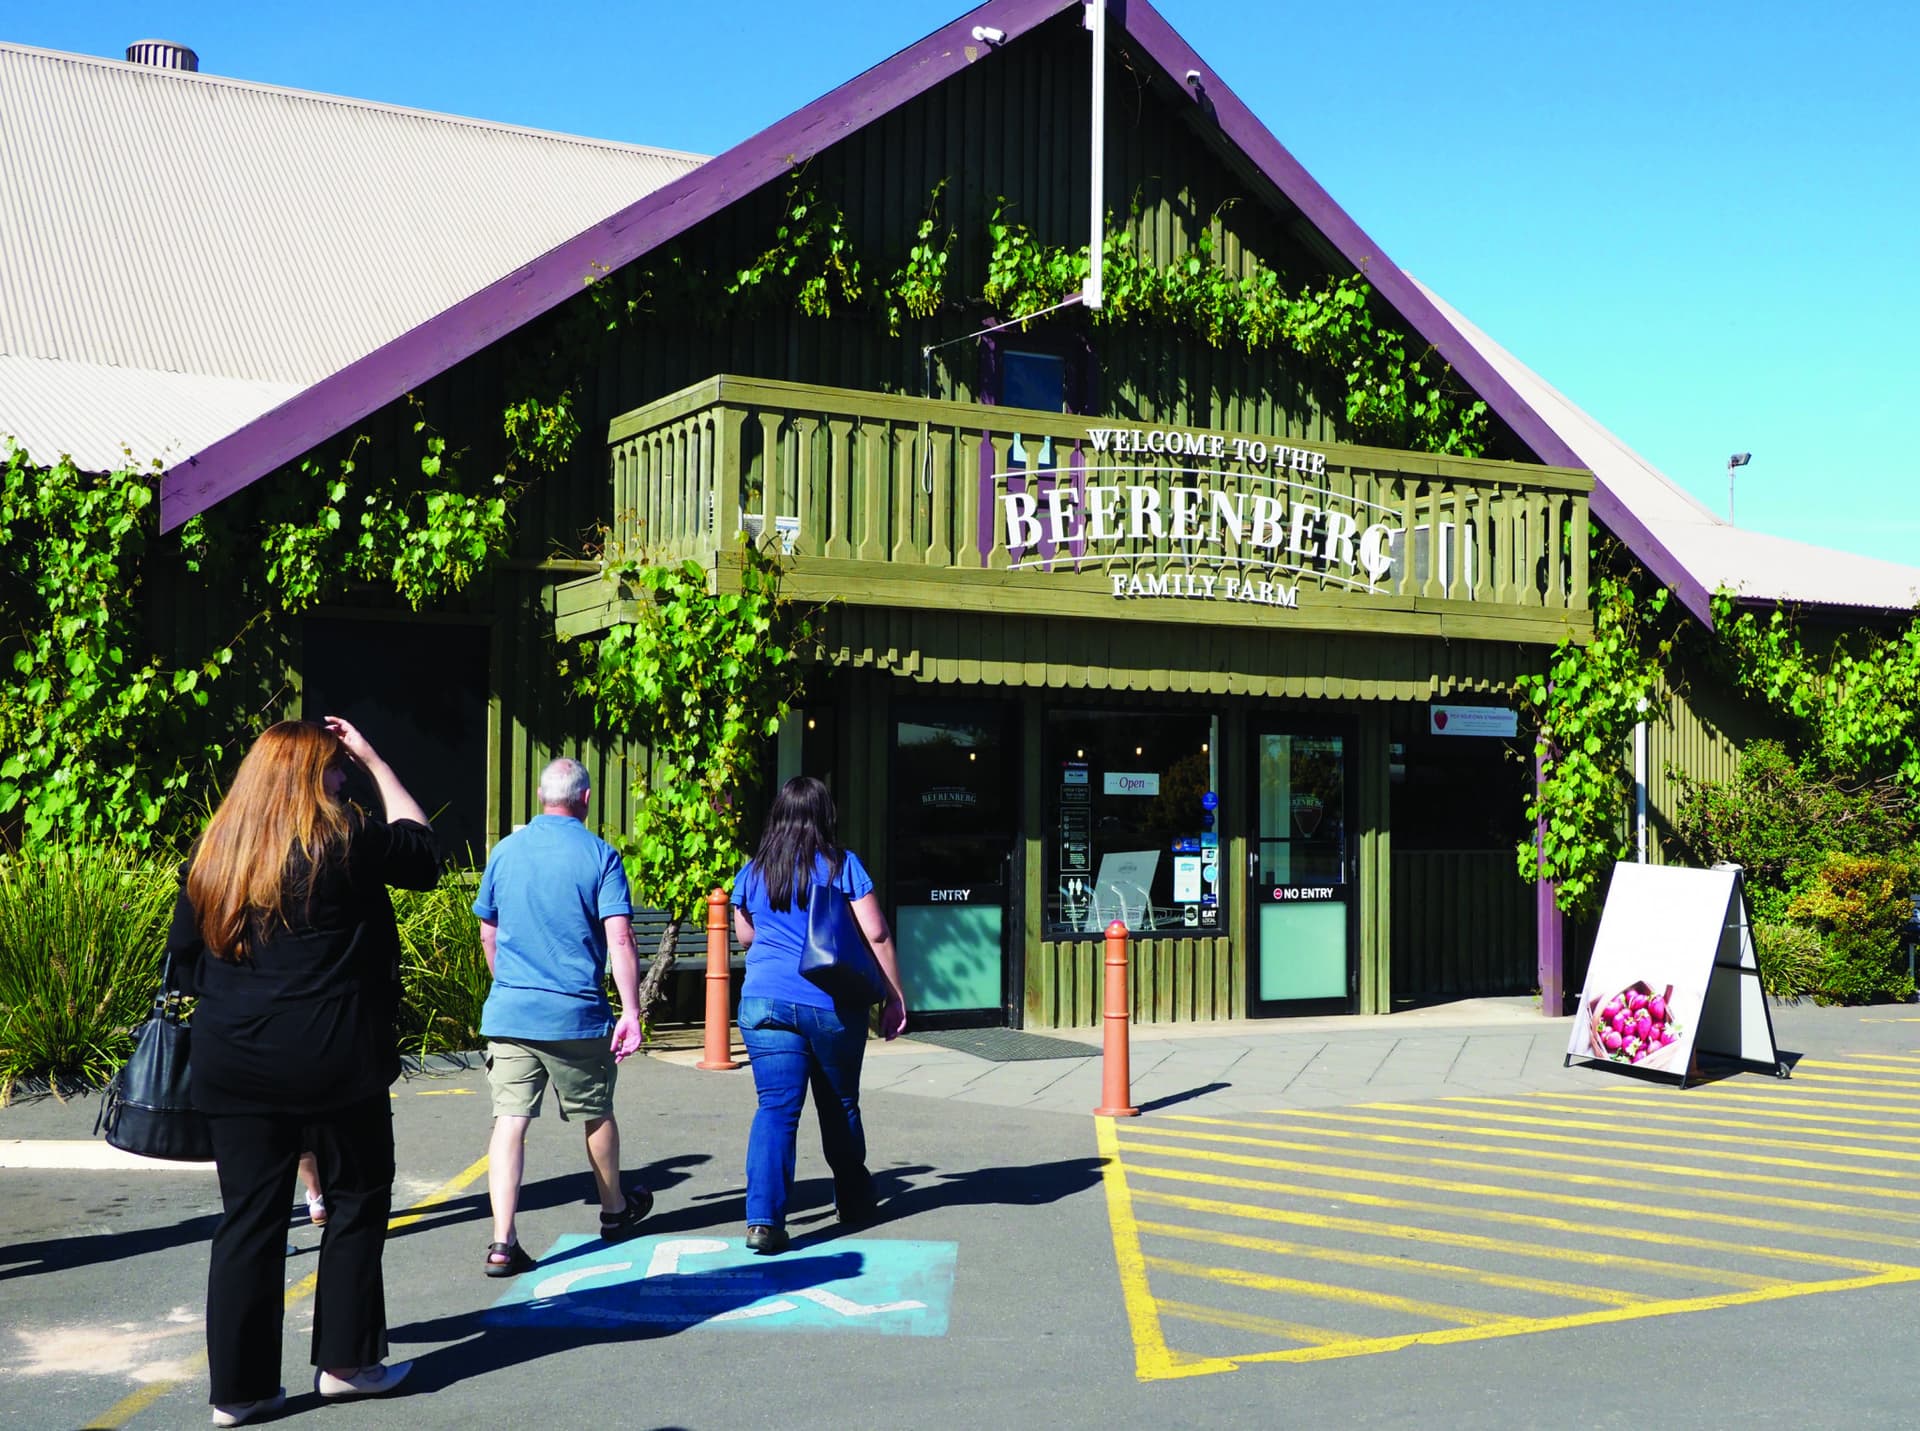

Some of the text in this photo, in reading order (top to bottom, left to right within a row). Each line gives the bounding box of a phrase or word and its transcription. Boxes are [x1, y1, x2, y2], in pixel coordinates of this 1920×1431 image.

[1086, 428, 1326, 475] WELCOME TO THE
[999, 486, 1397, 576] BEERENBERG
[1111, 573, 1299, 609] FAMILY FARM
[1119, 776, 1145, 791] Open
[930, 889, 970, 901] ENTRY
[1283, 887, 1333, 899] NO ENTRY
[1202, 910, 1216, 918] EAT
